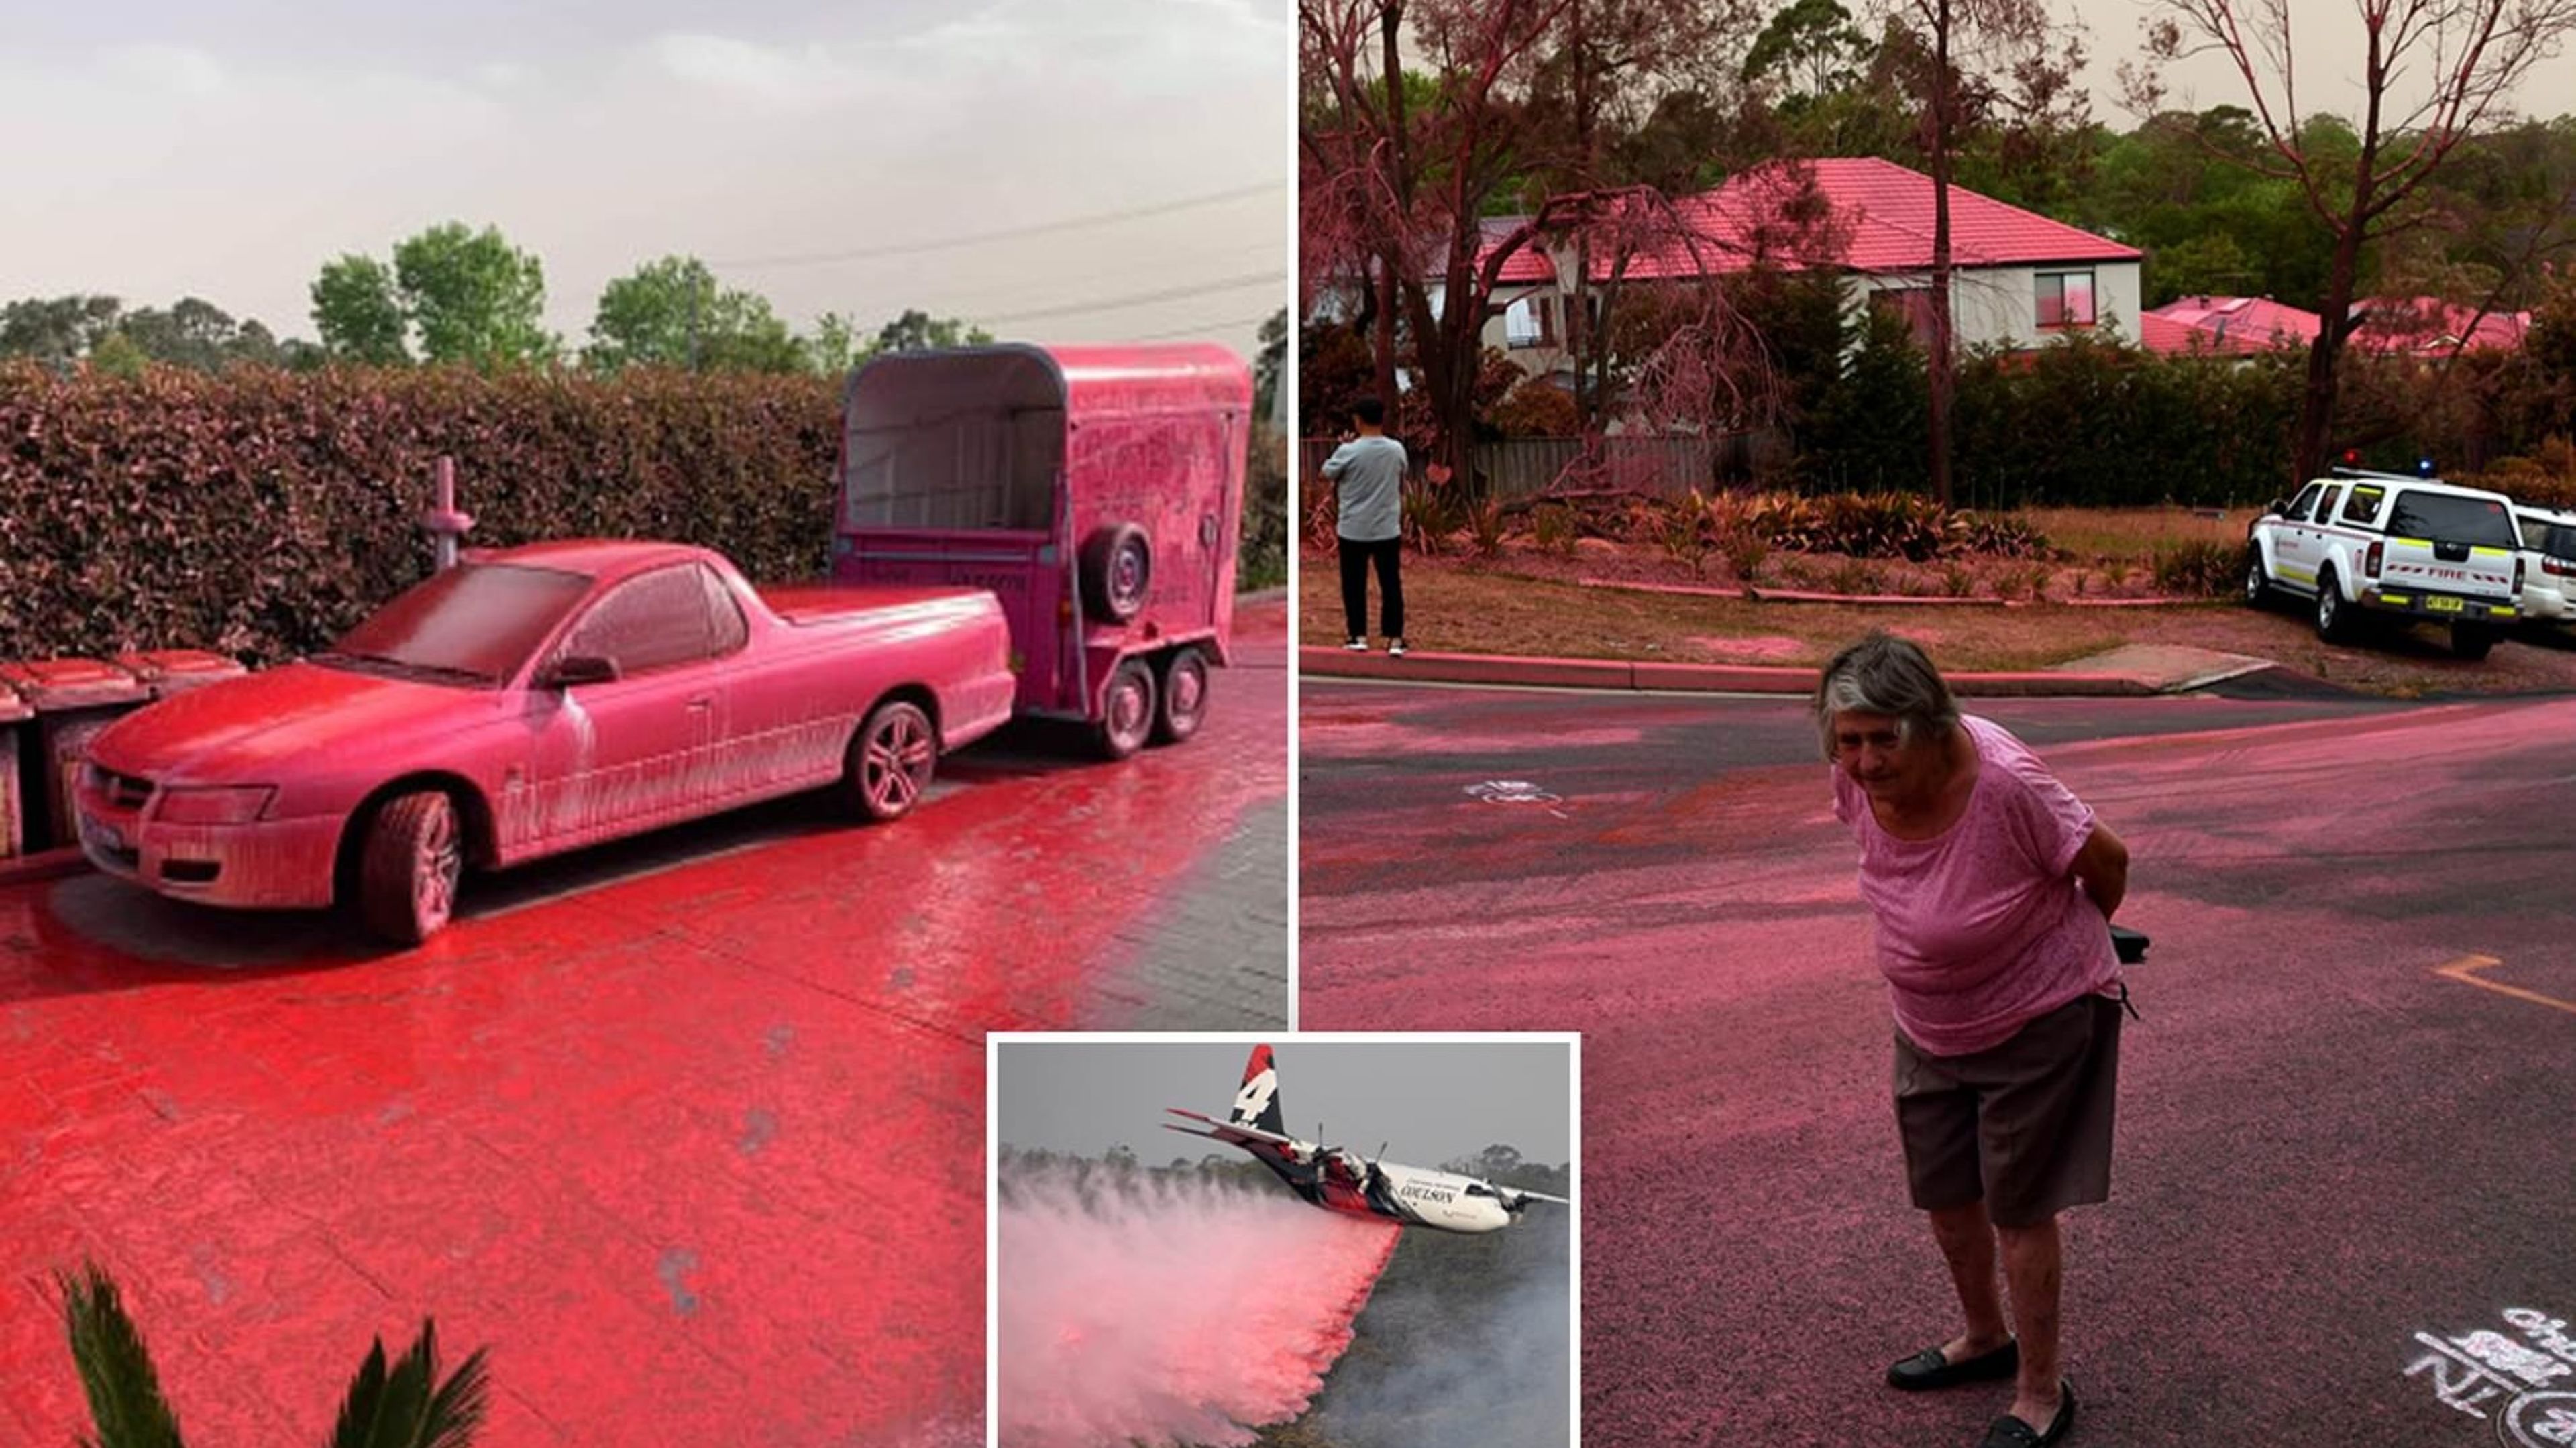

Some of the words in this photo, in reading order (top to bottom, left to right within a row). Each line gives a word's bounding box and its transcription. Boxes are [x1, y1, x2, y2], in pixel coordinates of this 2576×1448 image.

[2428, 567, 2466, 580] FIRE
[1234, 1068, 1277, 1121] 4
[1401, 1184, 1456, 1204] COULSON
